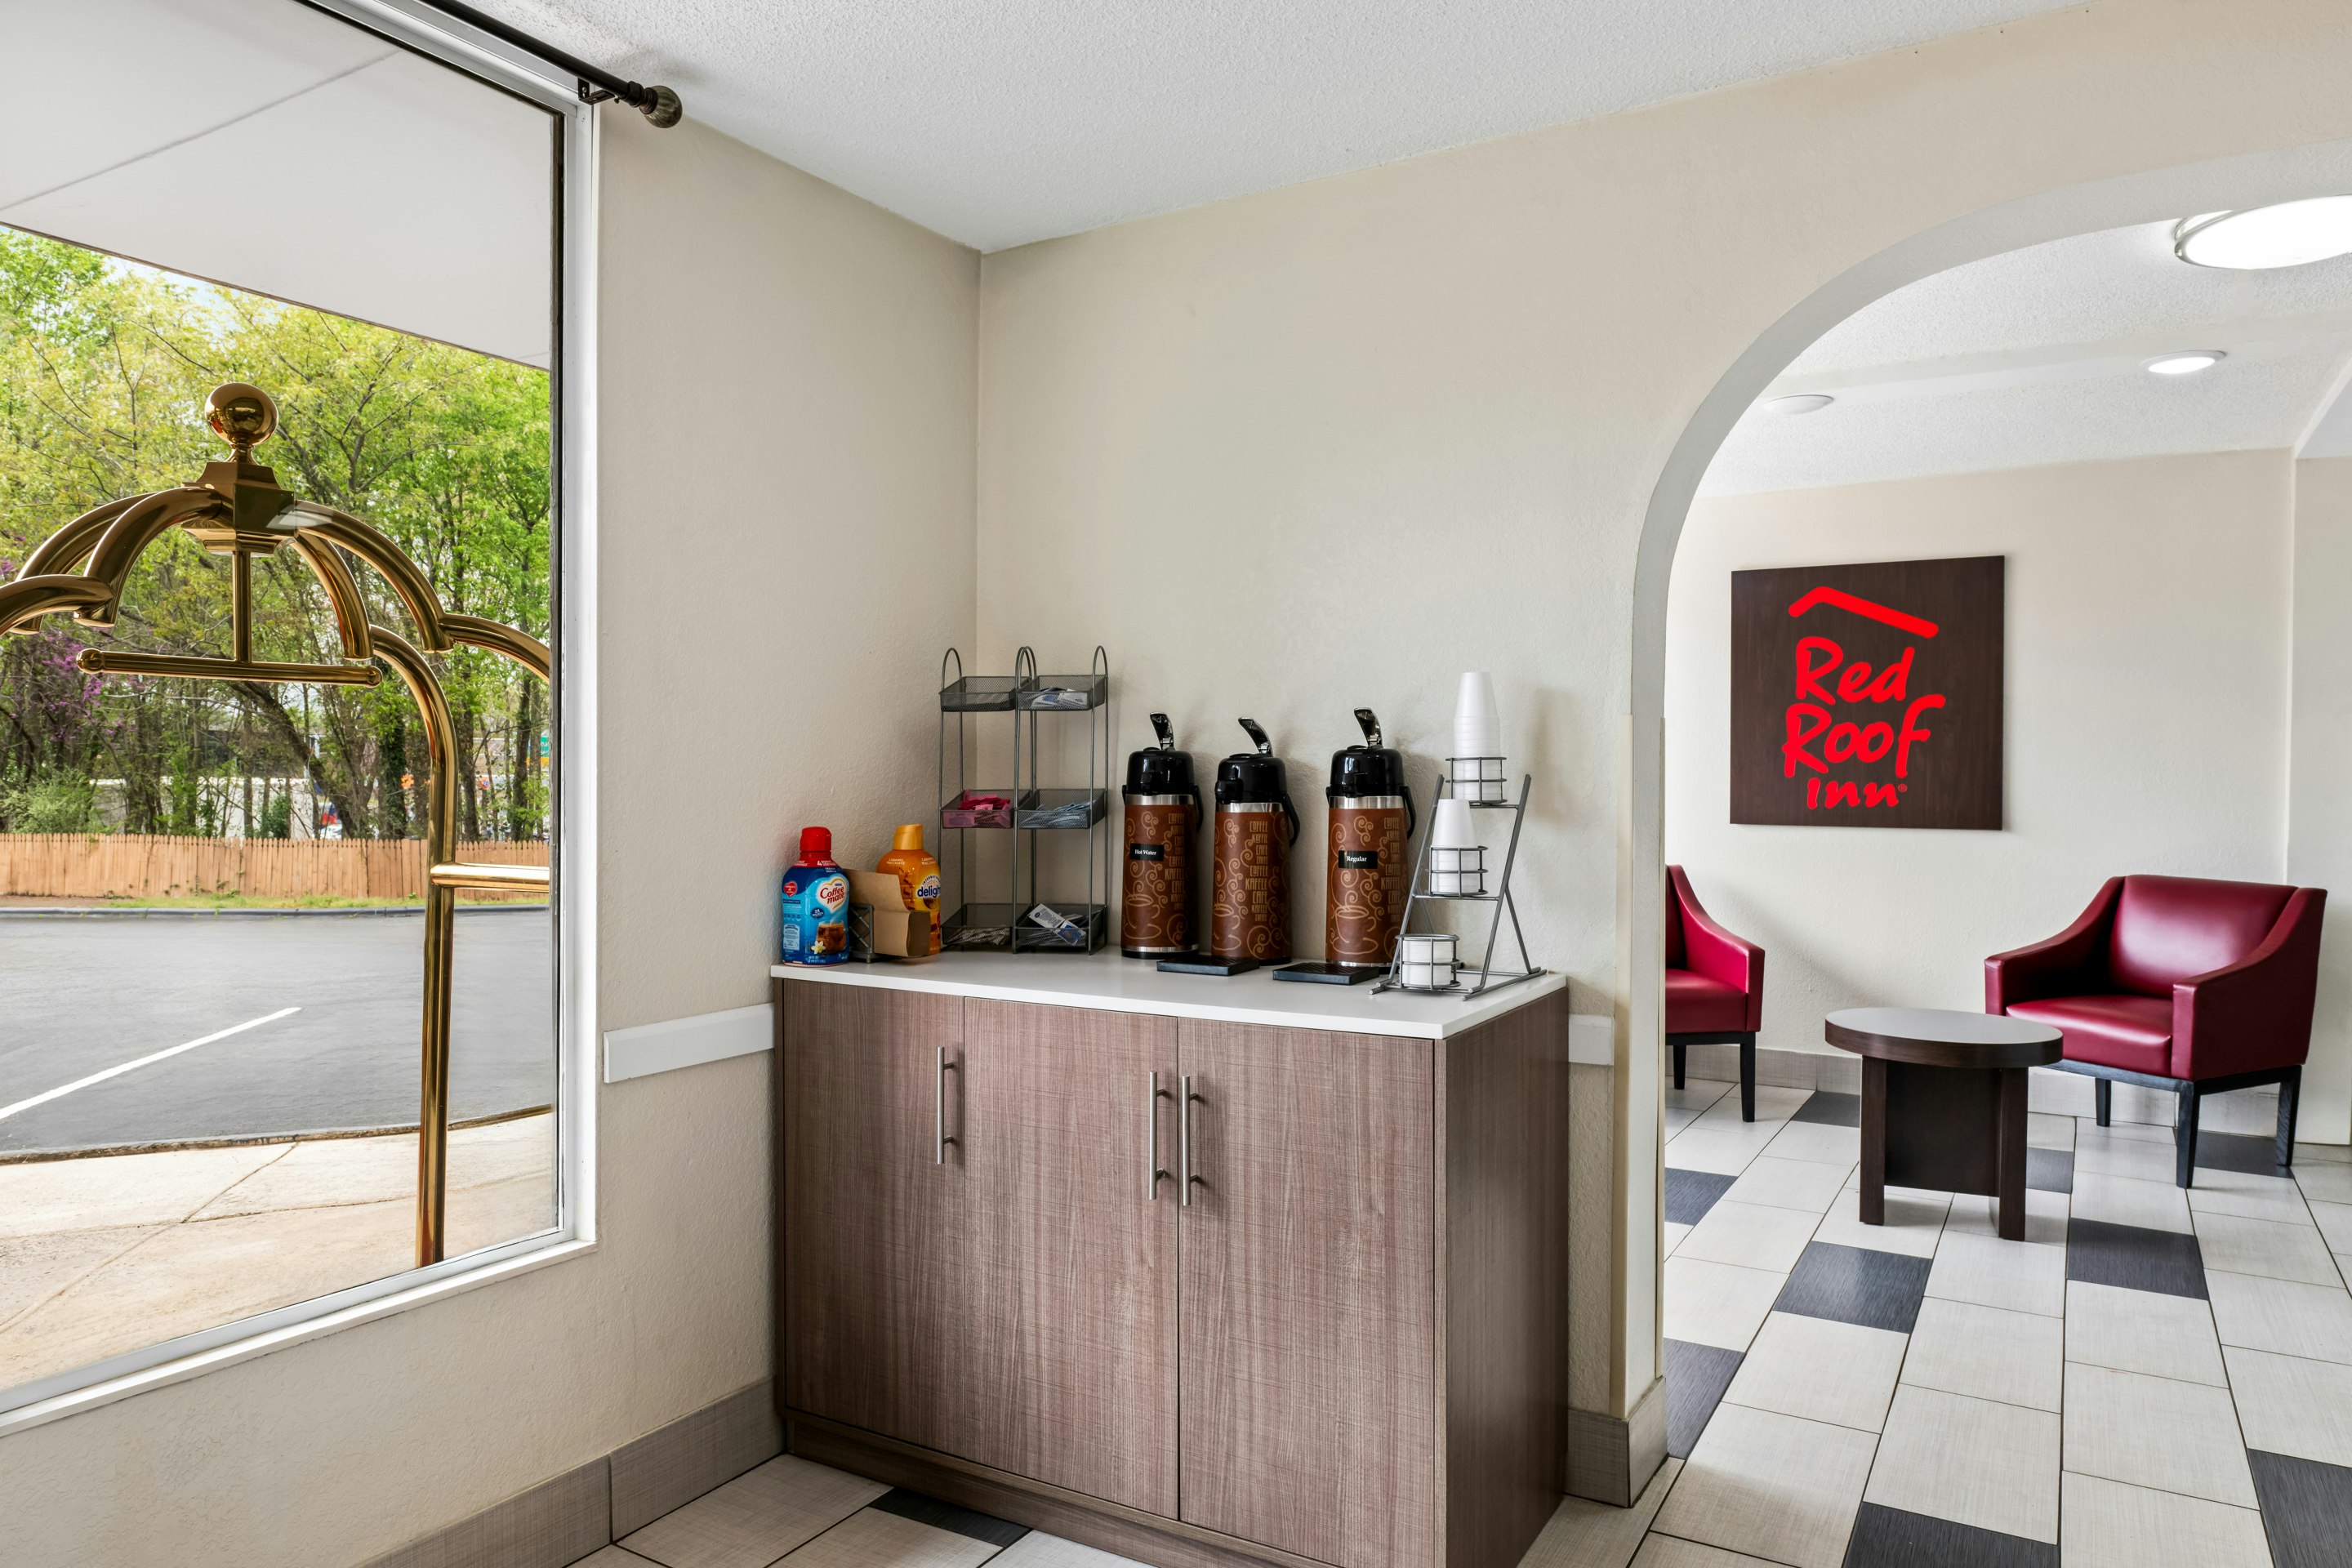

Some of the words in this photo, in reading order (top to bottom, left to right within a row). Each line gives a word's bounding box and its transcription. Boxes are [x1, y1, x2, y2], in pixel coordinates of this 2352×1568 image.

[1796, 636, 1915, 705] Red
[1782, 694, 1945, 777] Roof
[1807, 777, 1899, 809] Inn
[1250, 821, 1268, 832] COFFEE
[1346, 855, 1367, 863] Regular
[1250, 866, 1268, 876] COFFEE
[1245, 878, 1267, 890] KAFFEE
[820, 886, 844, 899] Coffee
[826, 892, 844, 904] mate
